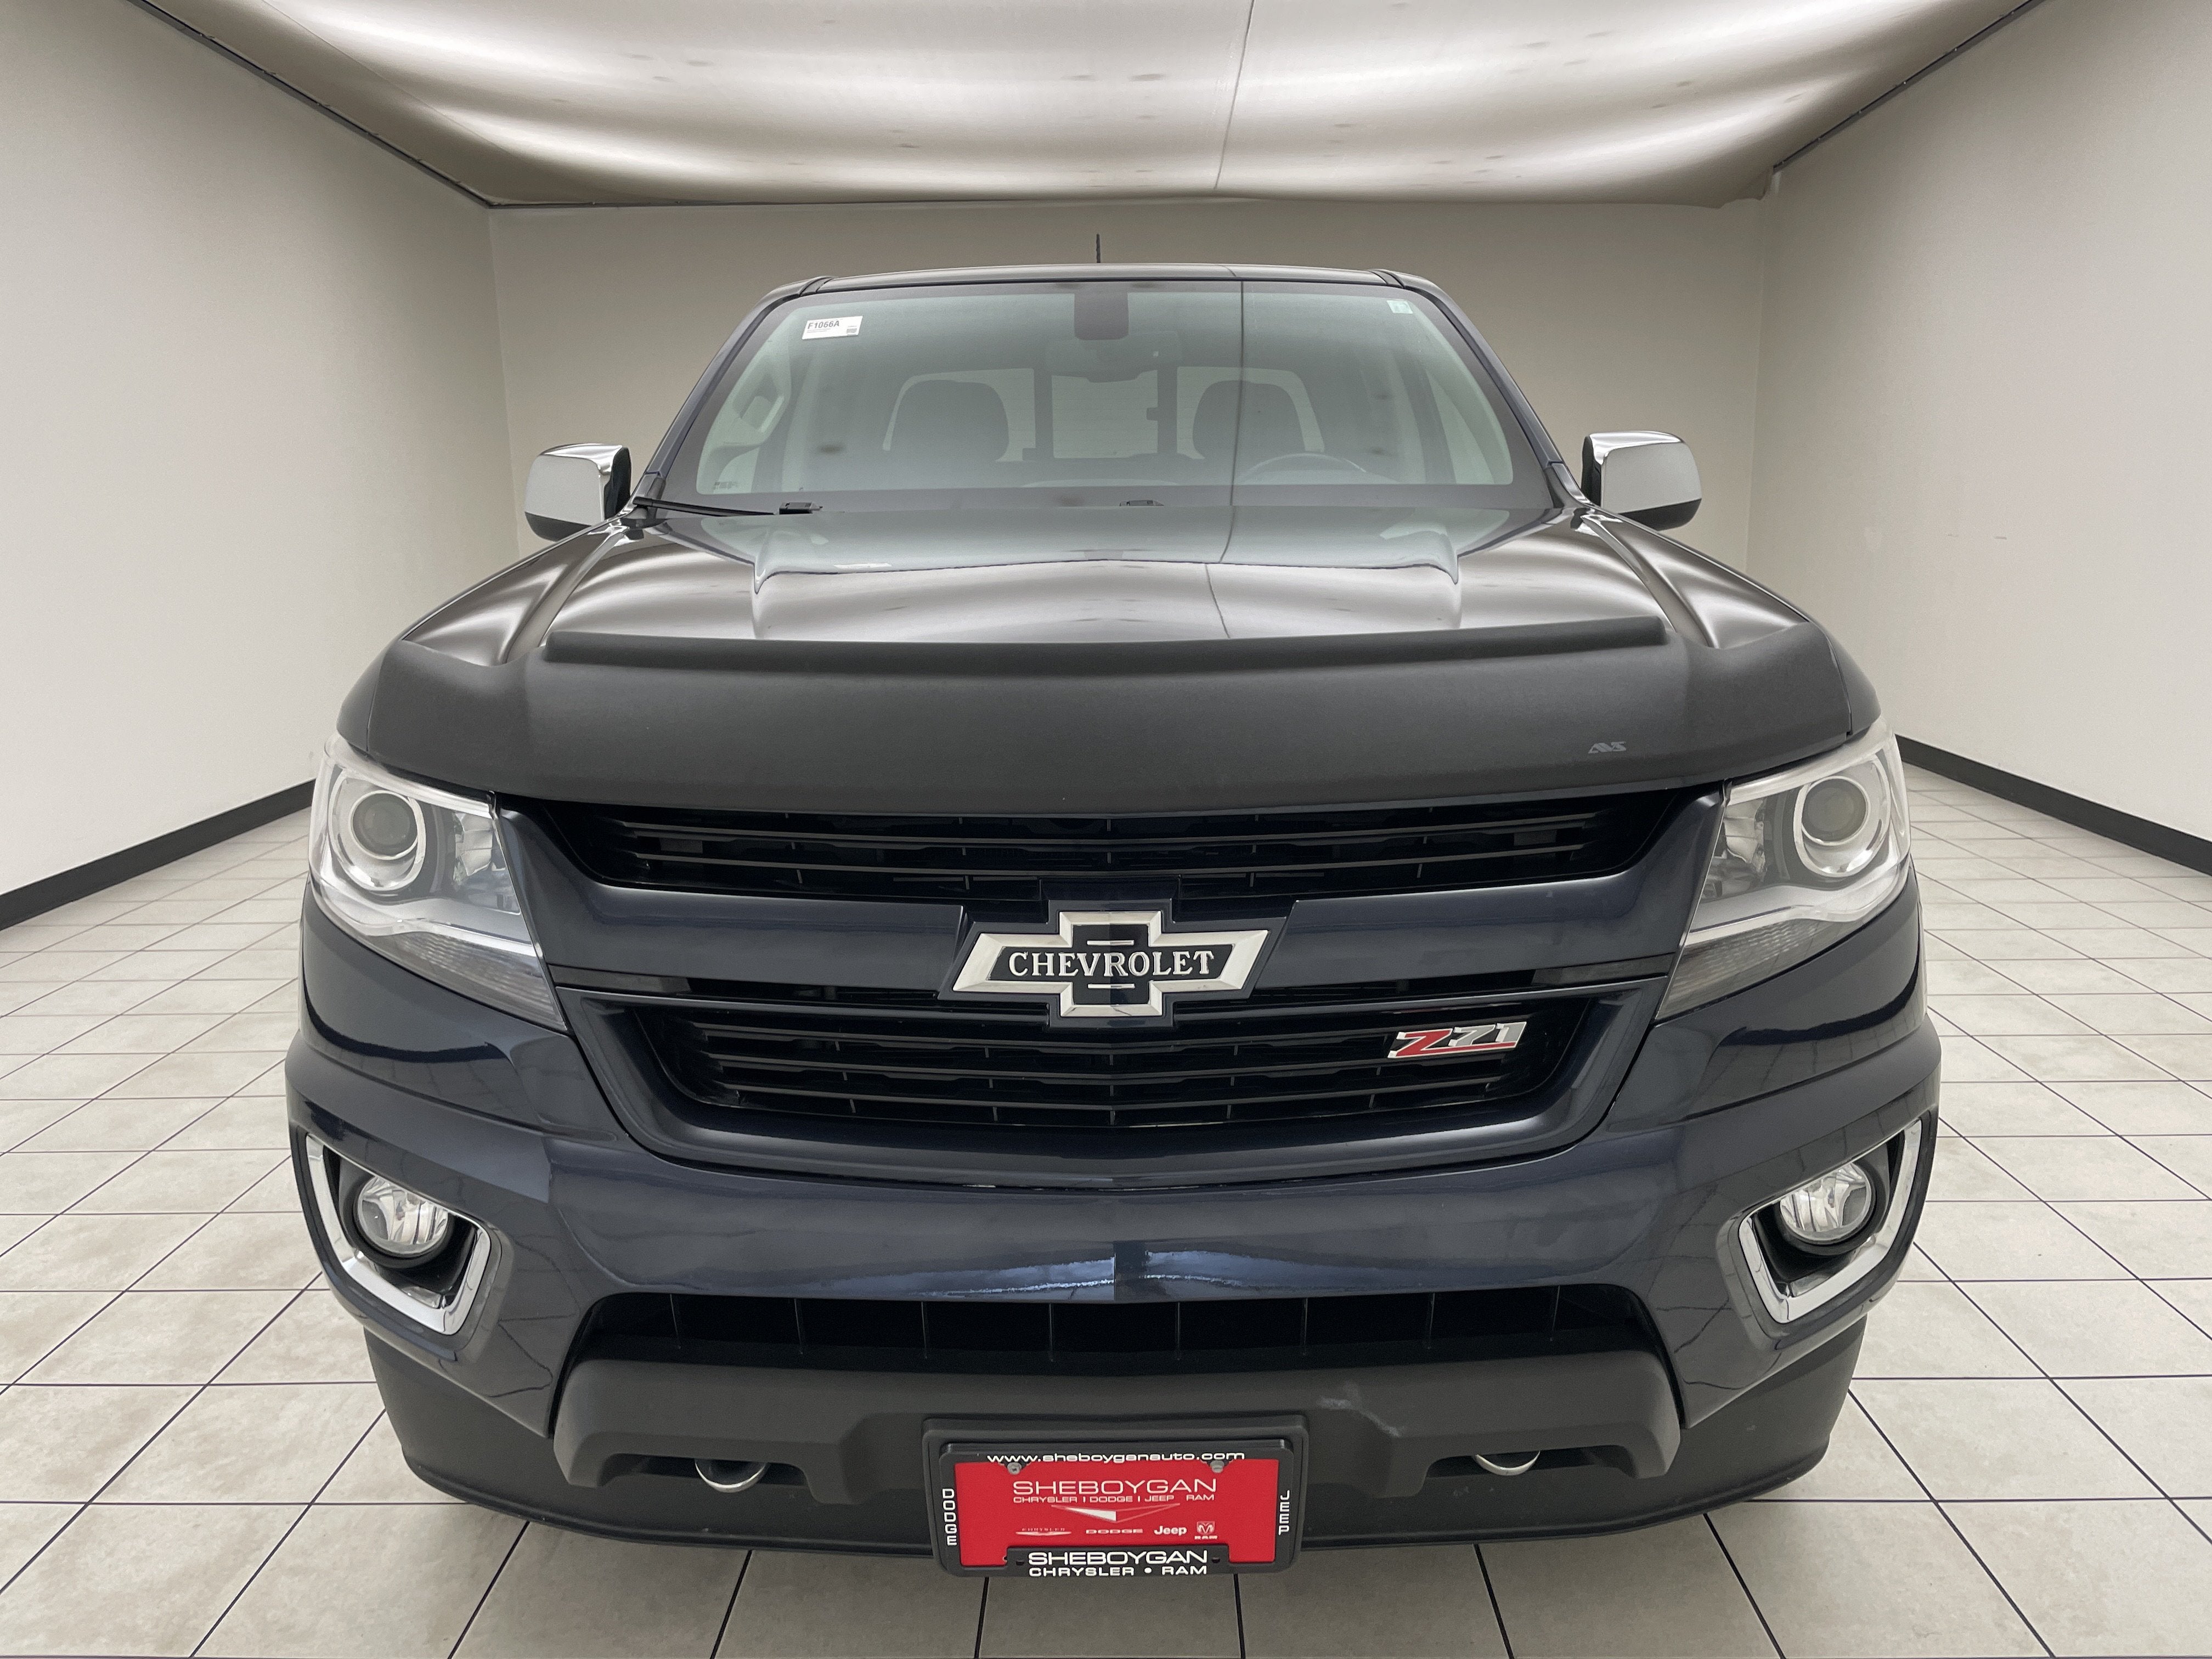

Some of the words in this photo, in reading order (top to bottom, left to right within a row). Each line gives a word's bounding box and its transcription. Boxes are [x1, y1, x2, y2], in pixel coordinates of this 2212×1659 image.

[808, 320, 840, 330] F1066A
[1008, 951, 1215, 977] CHEVROLET
[1387, 1021, 1527, 1059] Z71
[987, 1452, 1245, 1464] www.sheboyganauto.com
[1013, 1479, 1217, 1495] SHEBOYGAN
[1090, 1495, 1133, 1503] DODGE
[942, 1488, 957, 1546] DODGE
[1278, 1489, 1290, 1536] JEEP
[1154, 1526, 1187, 1536] Jeep
[1028, 1550, 1207, 1565] SHEBOYGAN
[1029, 1567, 1135, 1577] CHRYSLER
[1161, 1566, 1207, 1576] RAM
